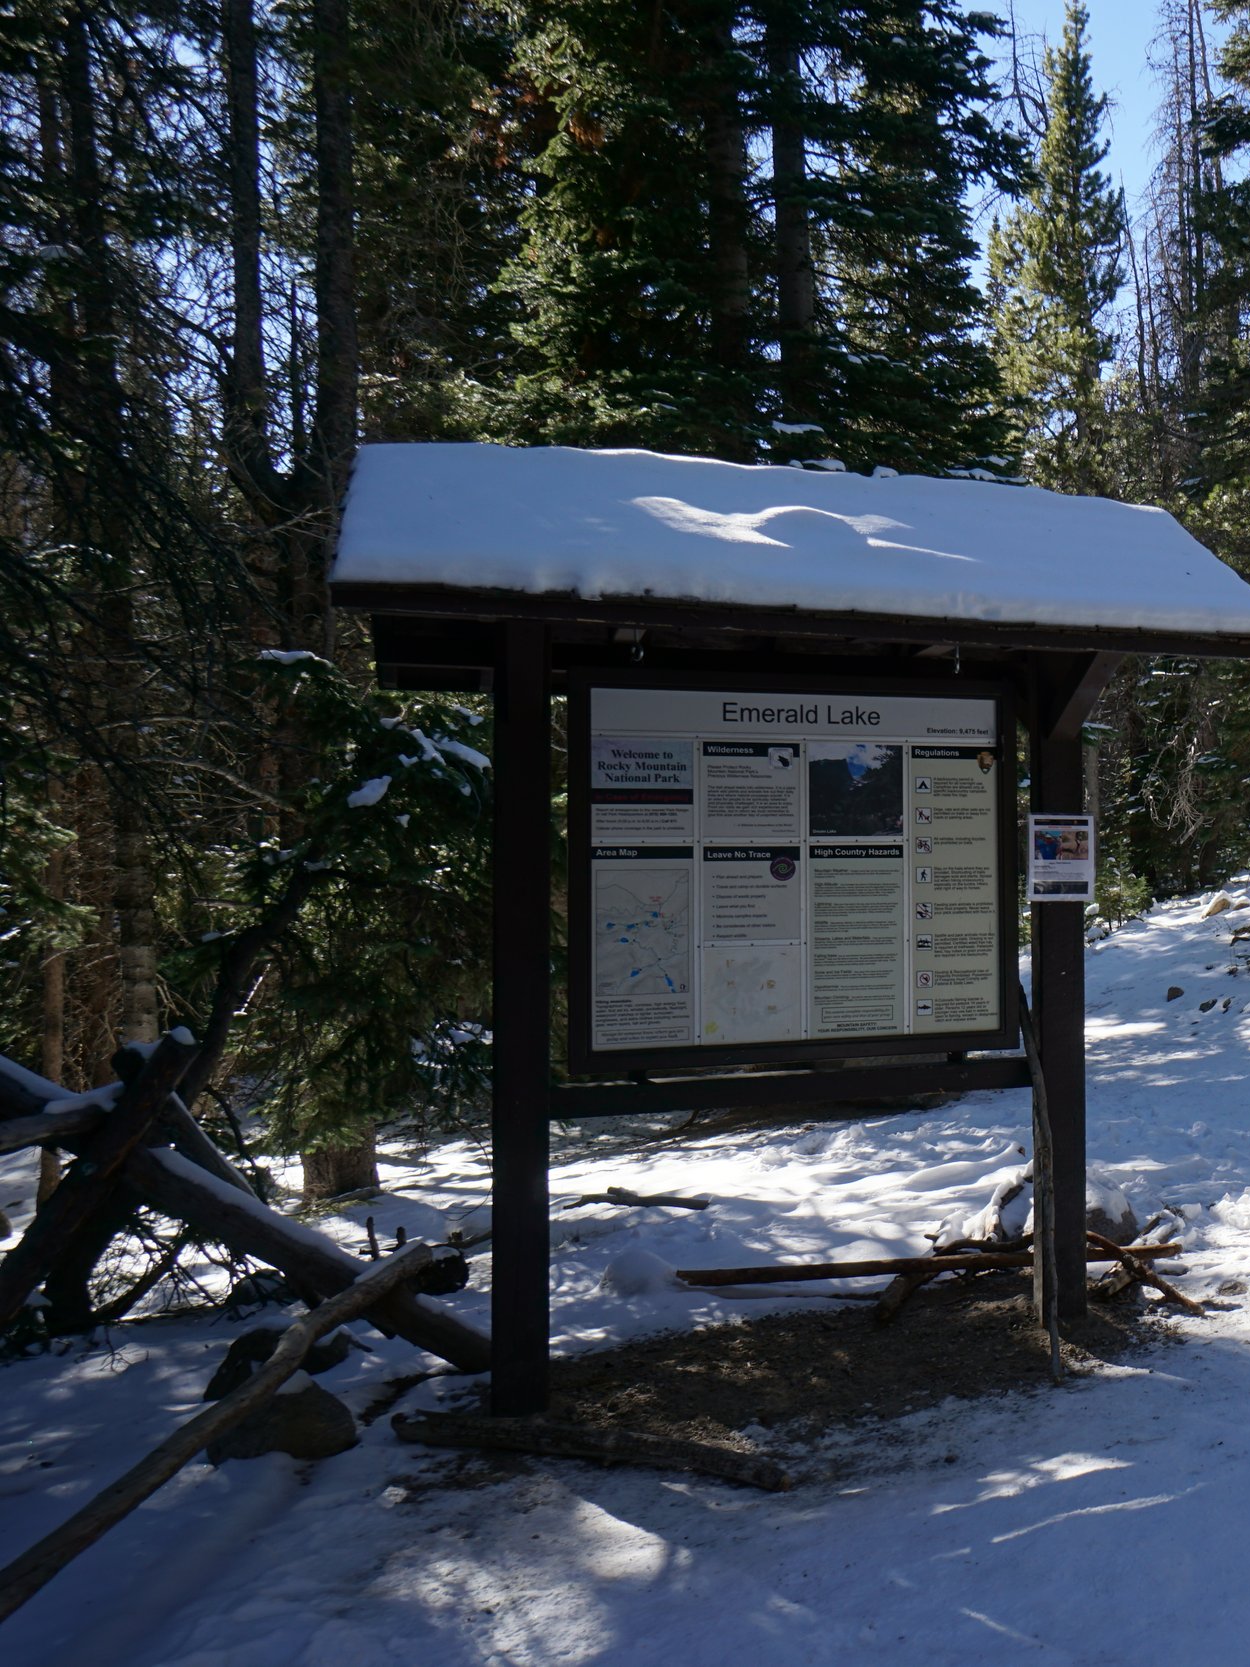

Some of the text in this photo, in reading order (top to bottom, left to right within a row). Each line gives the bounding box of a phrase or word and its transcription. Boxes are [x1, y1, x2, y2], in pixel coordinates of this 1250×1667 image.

[722, 702, 881, 726] Emerald Lake
[927, 727, 958, 735] Elevation:
[612, 749, 673, 760] Welcome to
[707, 746, 754, 754] Wilderness
[915, 749, 960, 758] Regulations
[598, 761, 687, 772] Rocky Mountain
[605, 773, 680, 783] National Park
[619, 849, 638, 857] Map
[814, 848, 900, 857] High Country Hazards
